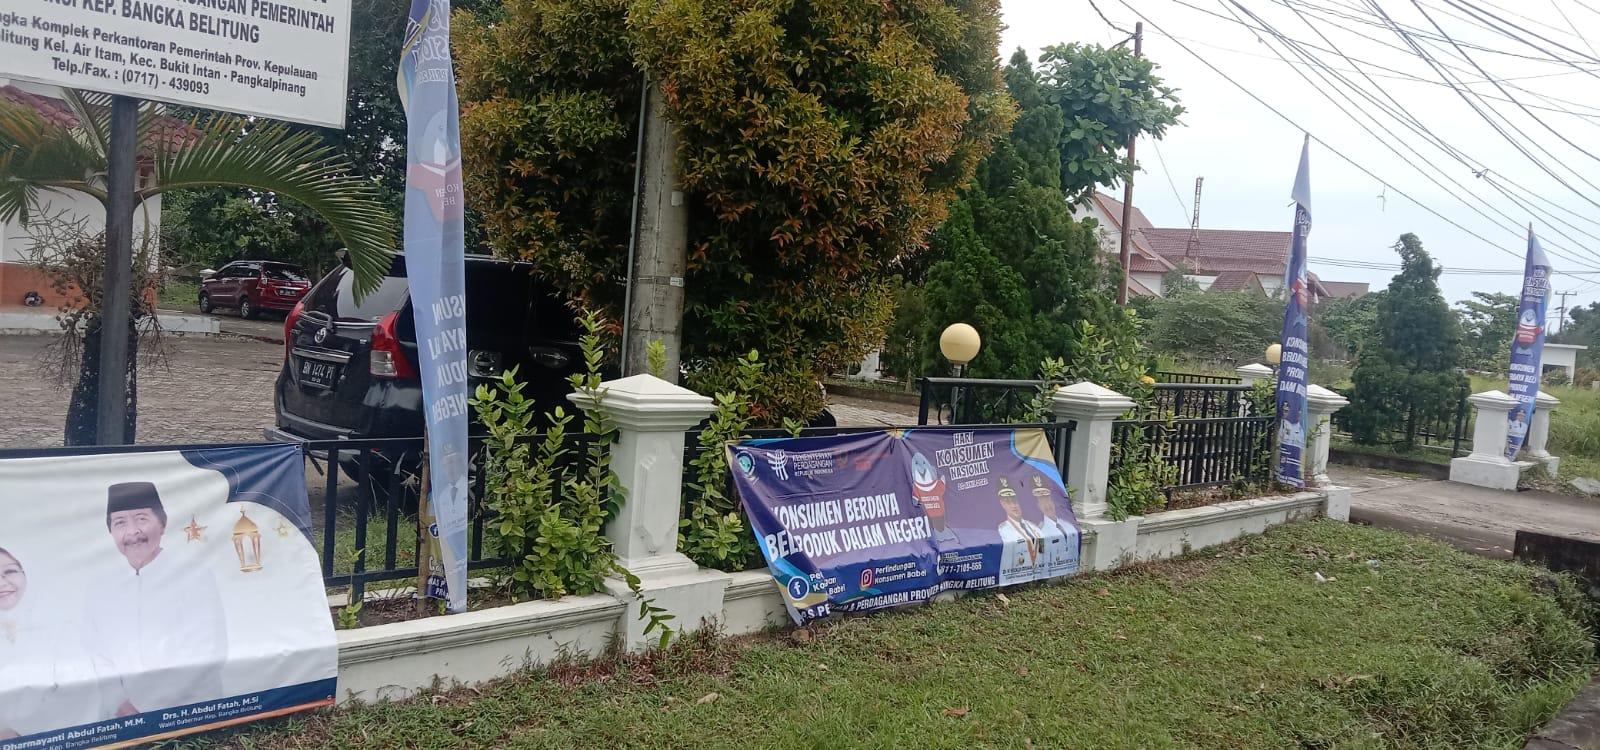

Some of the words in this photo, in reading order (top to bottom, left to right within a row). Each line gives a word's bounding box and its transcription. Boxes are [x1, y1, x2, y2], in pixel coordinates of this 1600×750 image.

[82, 0, 117, 15] KEP.
[121, 0, 185, 29] BANGKA
[189, 12, 260, 43] BELITUNG
[251, 0, 335, 33] PEMERINTAH
[31, 15, 90, 39] Komplek
[93, 27, 166, 53] Perkantoran
[169, 41, 232, 65] Pemerintah
[235, 54, 261, 70] Prov.
[264, 59, 318, 81] Kepulauan
[43, 36, 69, 53] Kel.
[73, 42, 92, 57] Air
[95, 45, 126, 66] Itam,
[130, 52, 156, 69] Kec.
[160, 58, 190, 74] Bukit
[193, 63, 221, 80] Intan
[230, 70, 307, 97] Pangkalpinang
[122, 68, 159, 90] (0717)
[169, 77, 210, 95] 439093
[936, 441, 995, 468] KONSUMEN
[953, 432, 975, 447] HARI
[949, 461, 990, 481] NASIONAL
[845, 492, 900, 523] BERDAYA
[840, 521, 887, 552] DALAM
[886, 515, 932, 545] NEGERI
[874, 573, 906, 585] Konsumen
[907, 569, 927, 578] Babel
[875, 561, 916, 575] Perlindungan
[856, 591, 909, 611] PERDAGANGAN
[965, 575, 997, 589] BELITUNG
[162, 712, 180, 721] Drs.
[181, 709, 190, 718] H.
[191, 704, 216, 715] Abdul
[242, 696, 259, 706] M.Si
[3, 733, 65, 750] Dharmayanti
[67, 728, 95, 740] Abdul
[124, 717, 146, 728] M.M.
